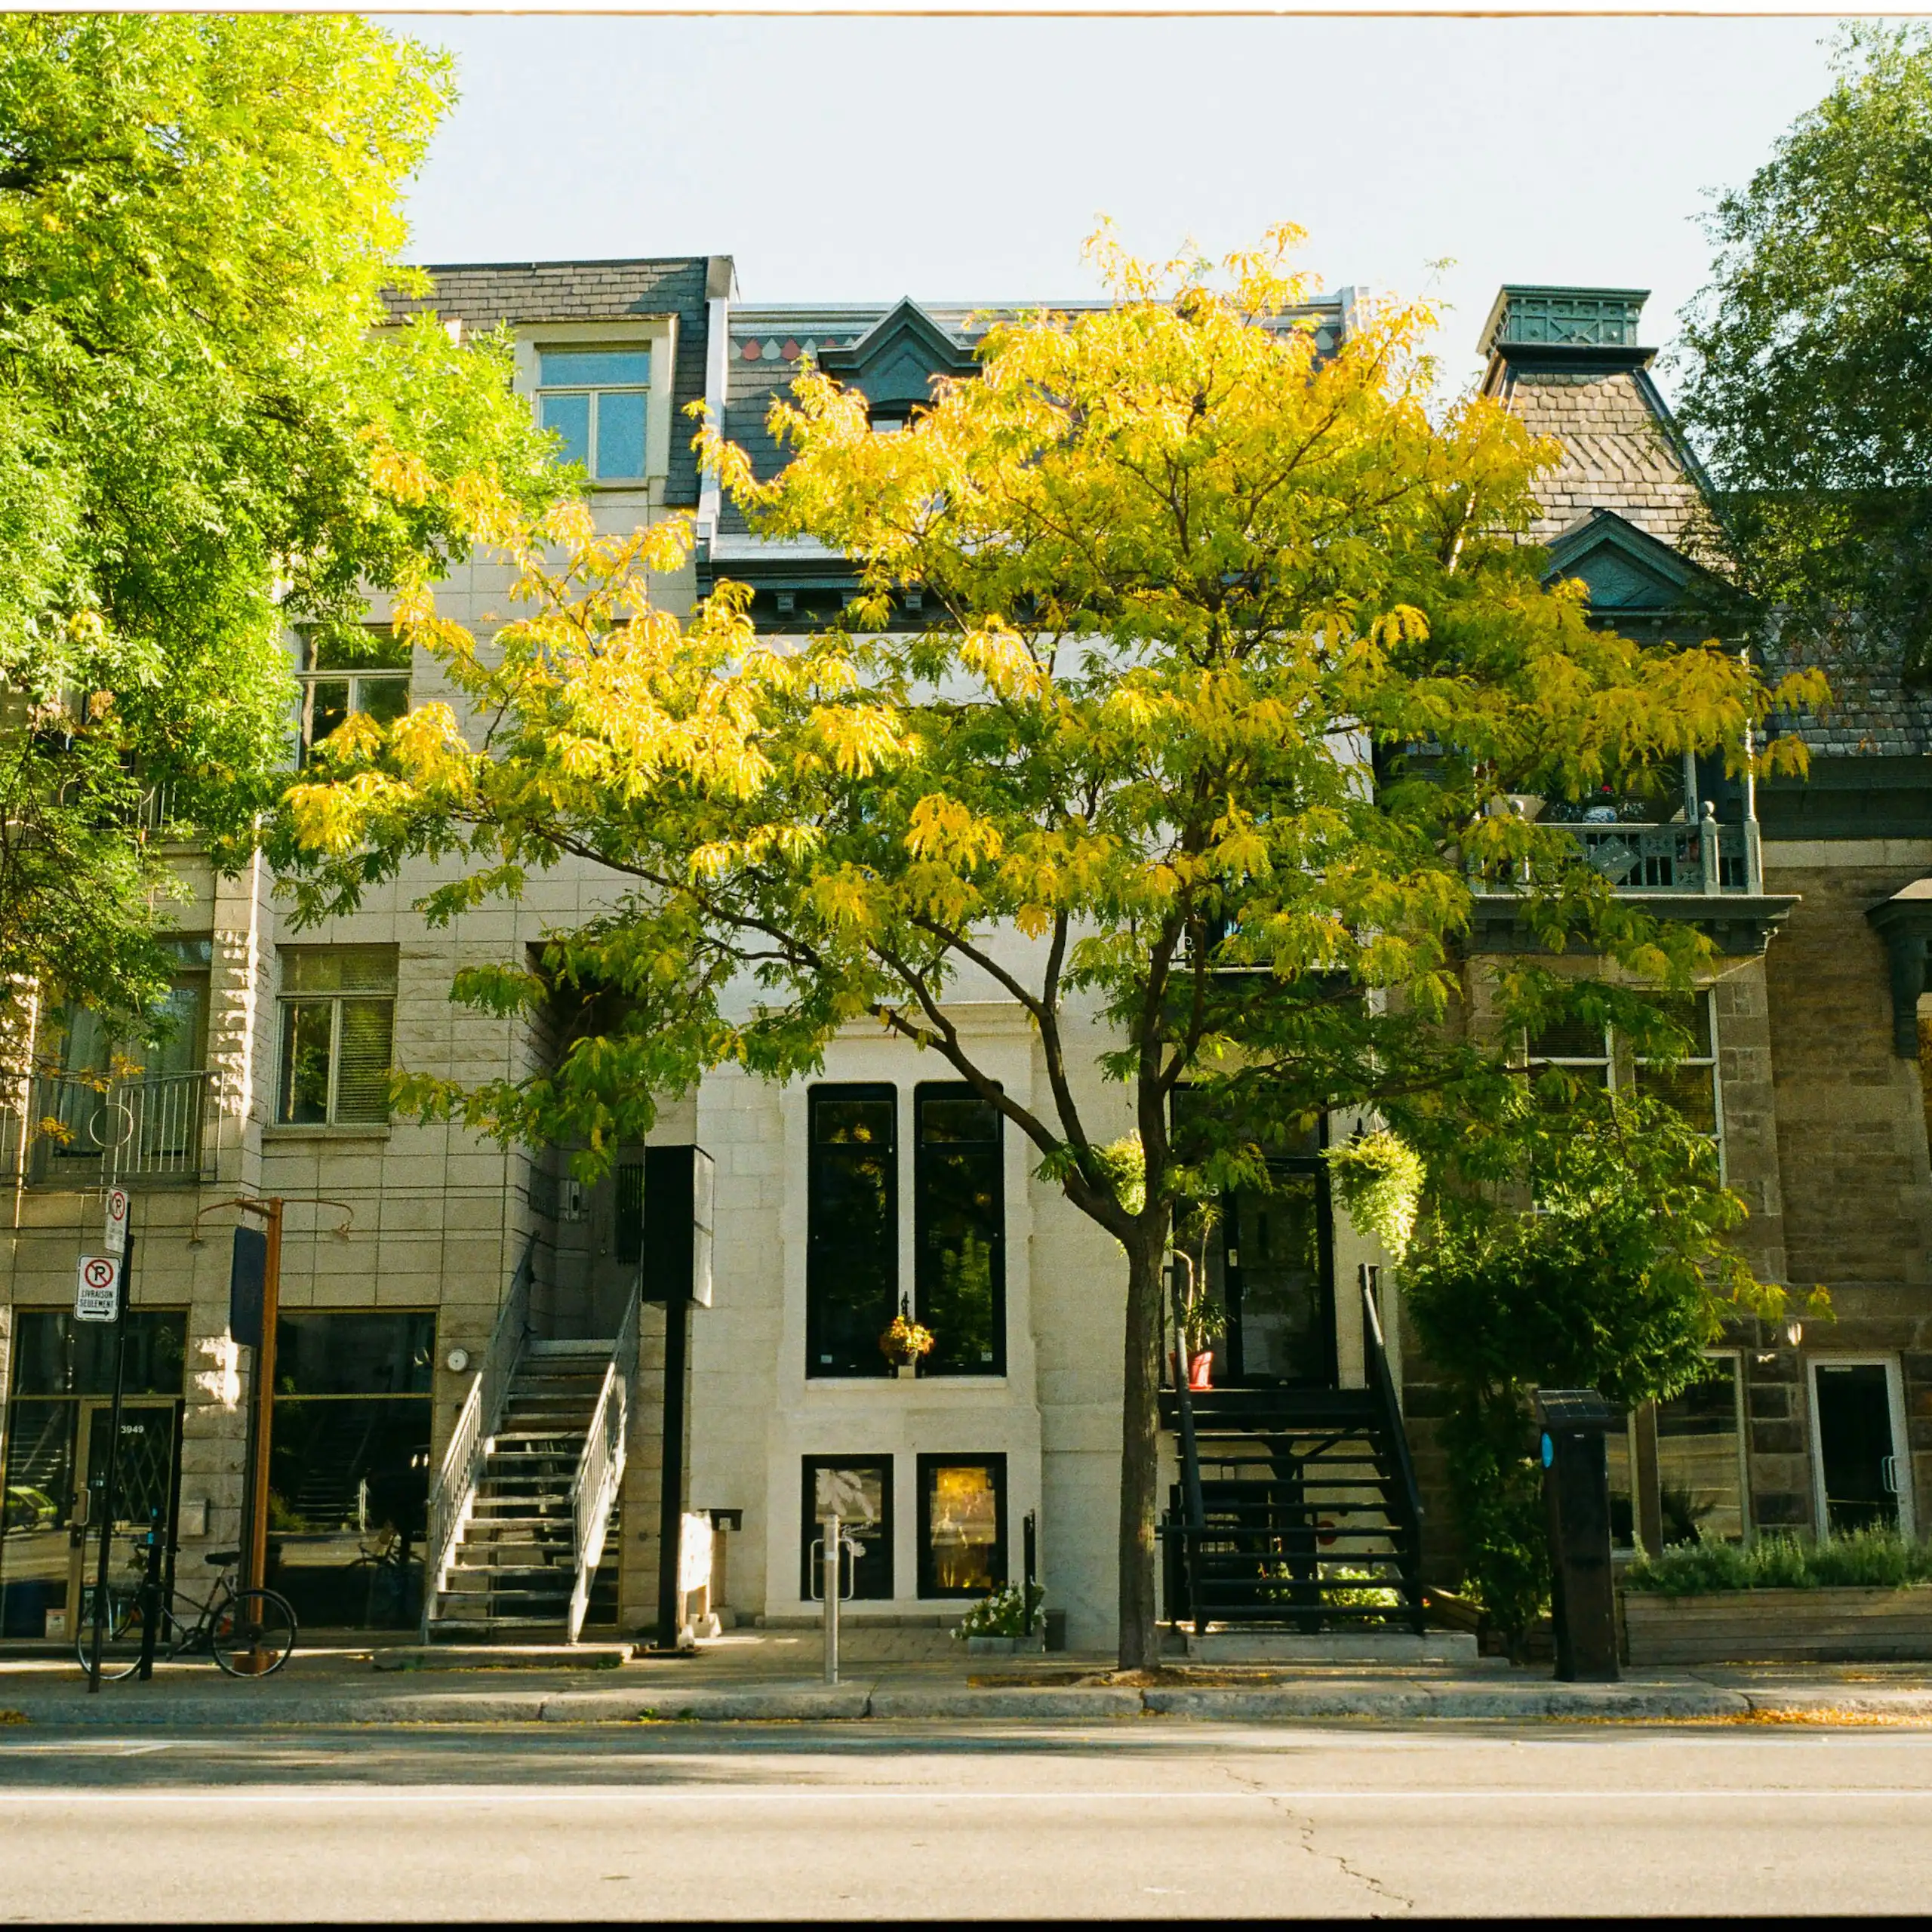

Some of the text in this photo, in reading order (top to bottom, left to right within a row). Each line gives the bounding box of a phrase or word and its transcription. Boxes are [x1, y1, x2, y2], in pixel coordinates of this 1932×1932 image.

[82, 1290, 113, 1298] LIVRAISON
[80, 1299, 114, 1308] SEULEMENT
[120, 1425, 144, 1434] 3949
